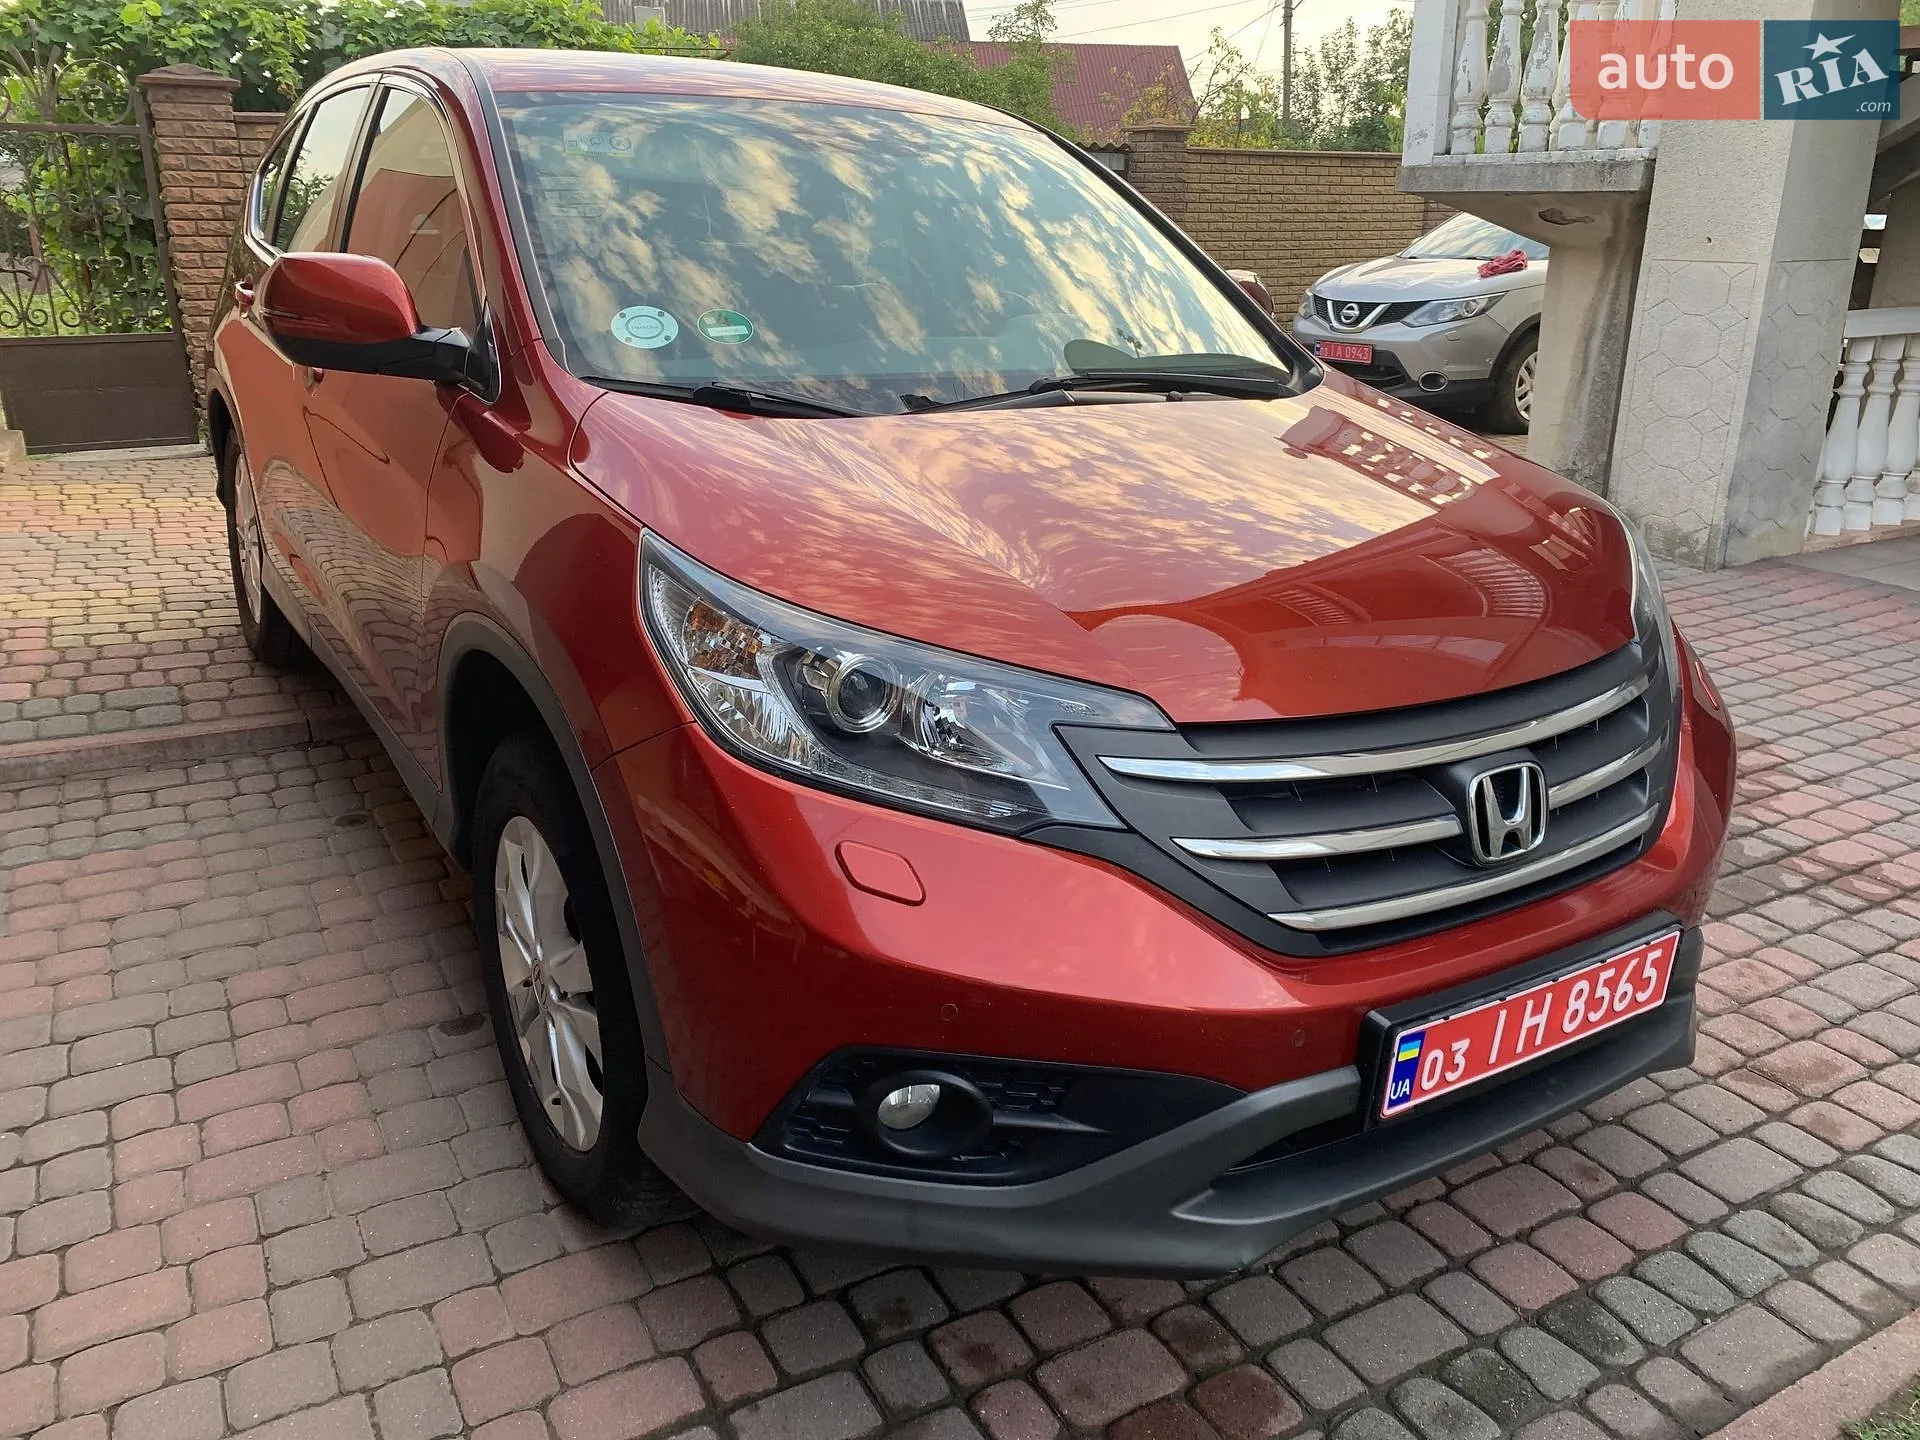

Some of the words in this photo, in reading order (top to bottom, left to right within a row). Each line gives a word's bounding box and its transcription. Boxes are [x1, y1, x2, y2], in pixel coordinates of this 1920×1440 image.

[1345, 346, 1369, 360] 0943
[1420, 1038, 1470, 1091] 03
[1488, 992, 1553, 1065] IH
[1561, 948, 1663, 1034] 8565
[1390, 1078, 1411, 1101] UA
